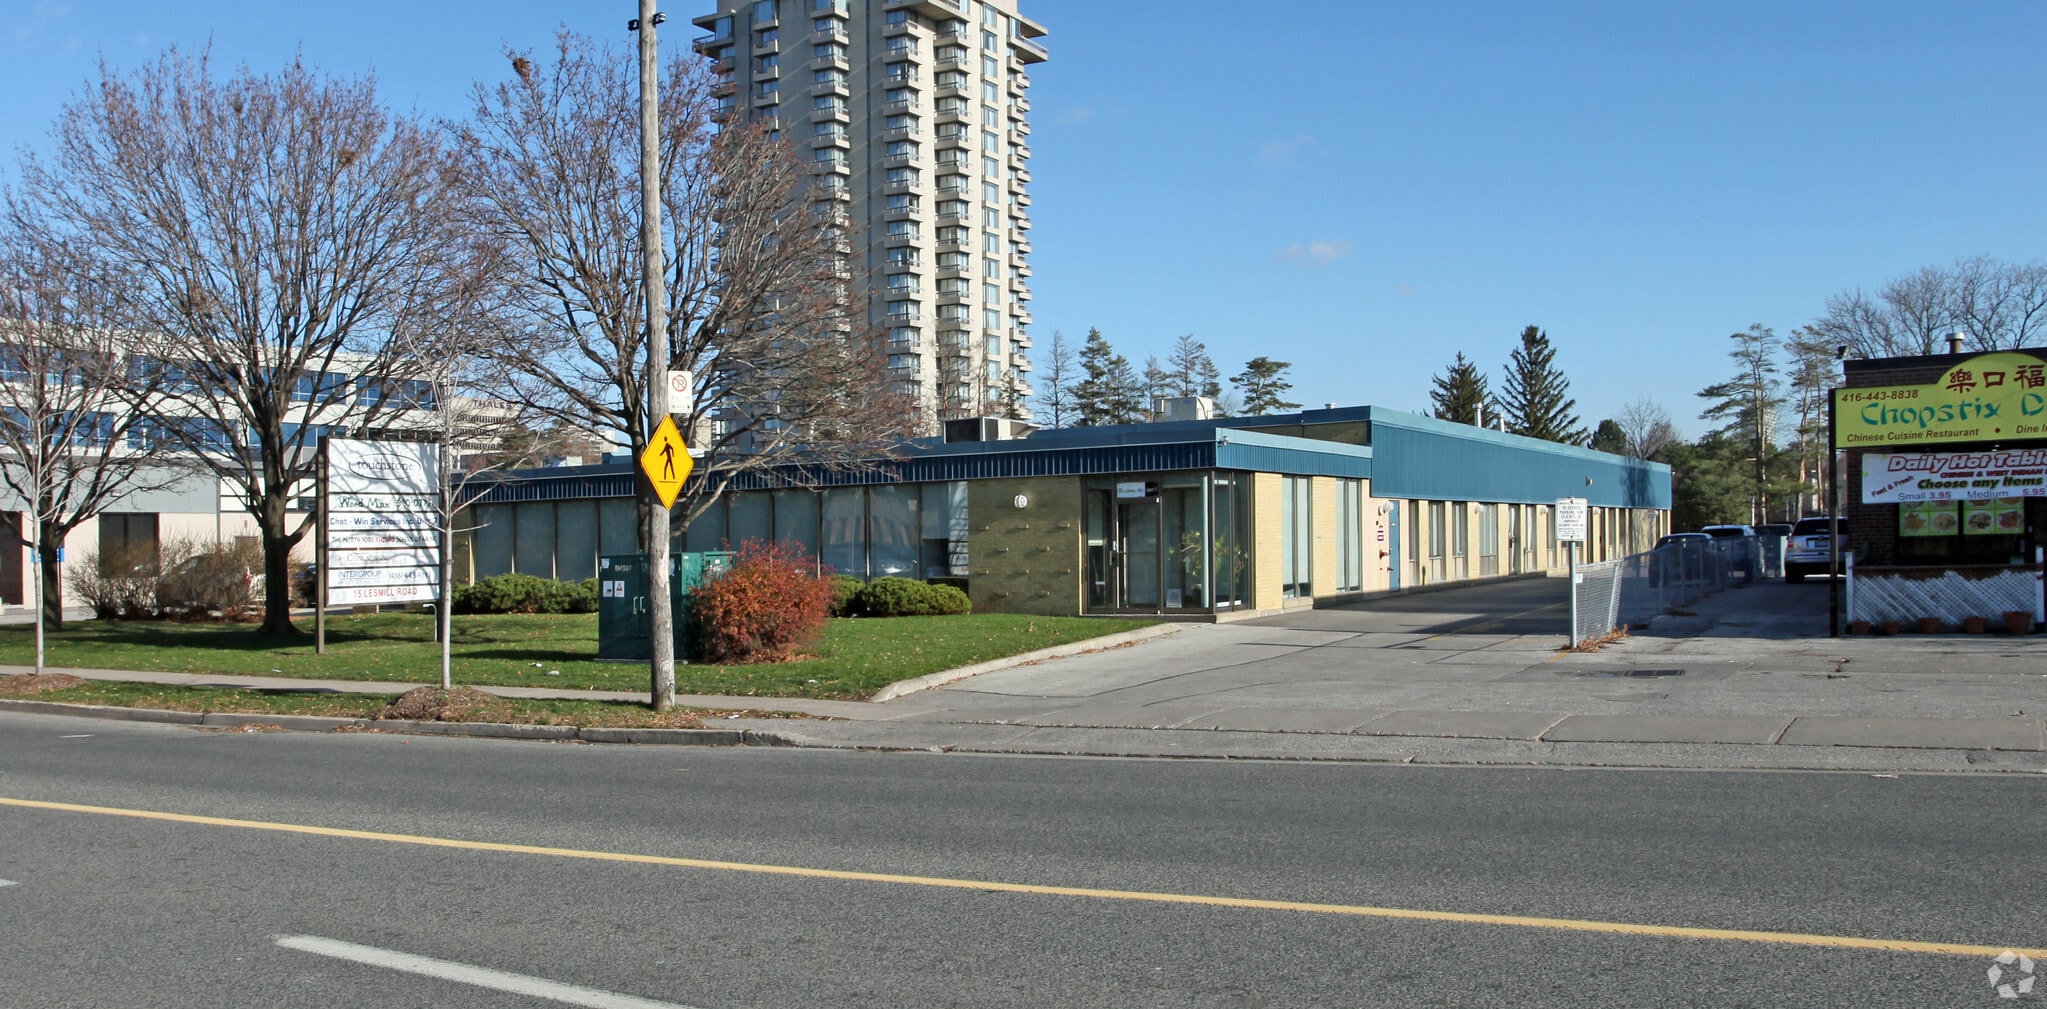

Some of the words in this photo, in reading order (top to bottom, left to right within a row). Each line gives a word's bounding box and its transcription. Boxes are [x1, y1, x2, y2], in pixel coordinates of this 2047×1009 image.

[1841, 389, 1919, 403] 416-443-8838
[473, 400, 513, 410] THALES
[1861, 397, 2001, 429] Chopstix
[2016, 424, 2040, 434] Dine
[1847, 432, 1885, 443] Chinese
[1887, 430, 1923, 441] Cuisine
[1925, 428, 1979, 439] Restaurant
[357, 458, 414, 470] touchstone
[1887, 454, 1949, 474] Daily
[1949, 453, 1992, 470] Hot
[1871, 486, 1888, 498] Fast
[1893, 475, 1914, 488] Fresh
[1917, 478, 1968, 490] Choose
[1972, 478, 1999, 490] any
[1898, 491, 1927, 501] Small
[1929, 490, 1951, 499] 3.95
[1967, 490, 2009, 499] Medium
[2021, 487, 2046, 496] 5.95
[353, 517, 369, 525] Win
[338, 570, 382, 579] INTERGROUP
[354, 590, 362, 598] 15
[363, 588, 395, 598] LESMILL
[397, 587, 418, 596] ROAD
